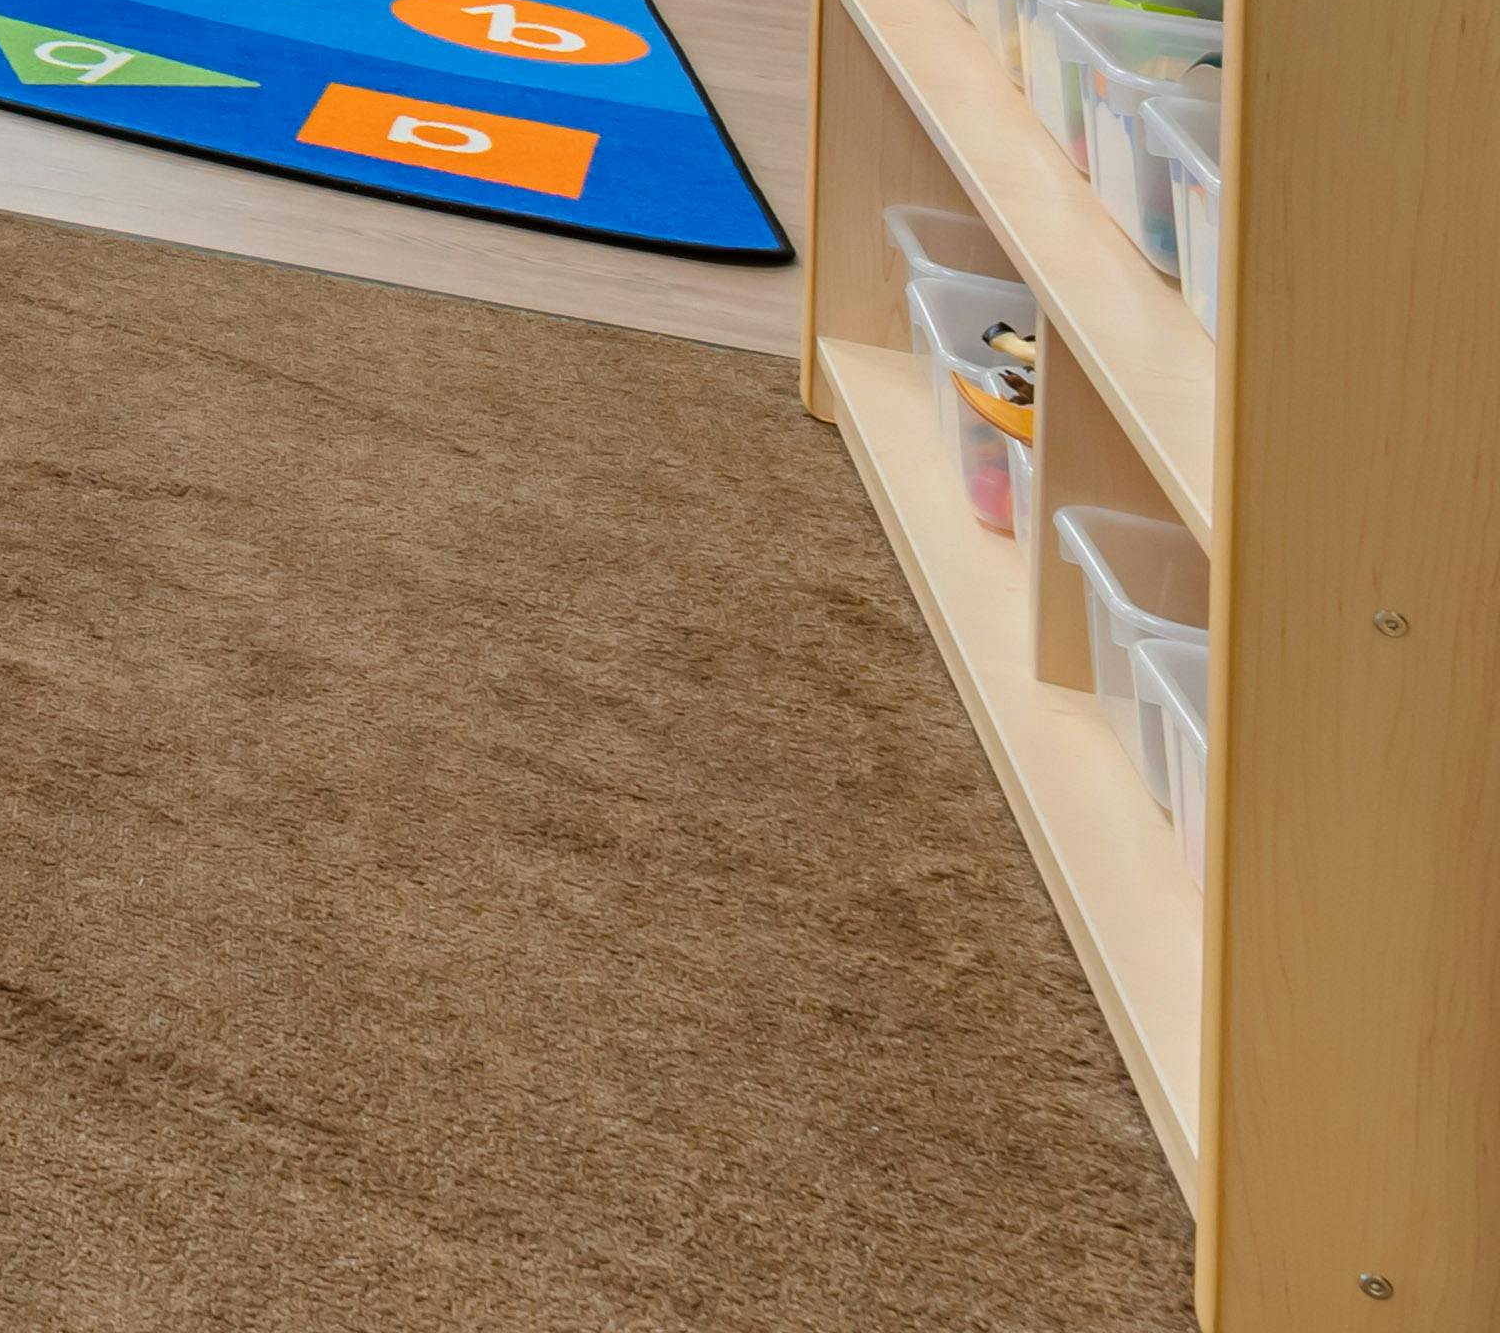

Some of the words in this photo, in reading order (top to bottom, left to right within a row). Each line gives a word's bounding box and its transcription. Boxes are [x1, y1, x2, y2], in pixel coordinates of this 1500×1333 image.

[459, 3, 588, 55] q
[33, 40, 137, 83] b
[386, 115, 493, 154] a
